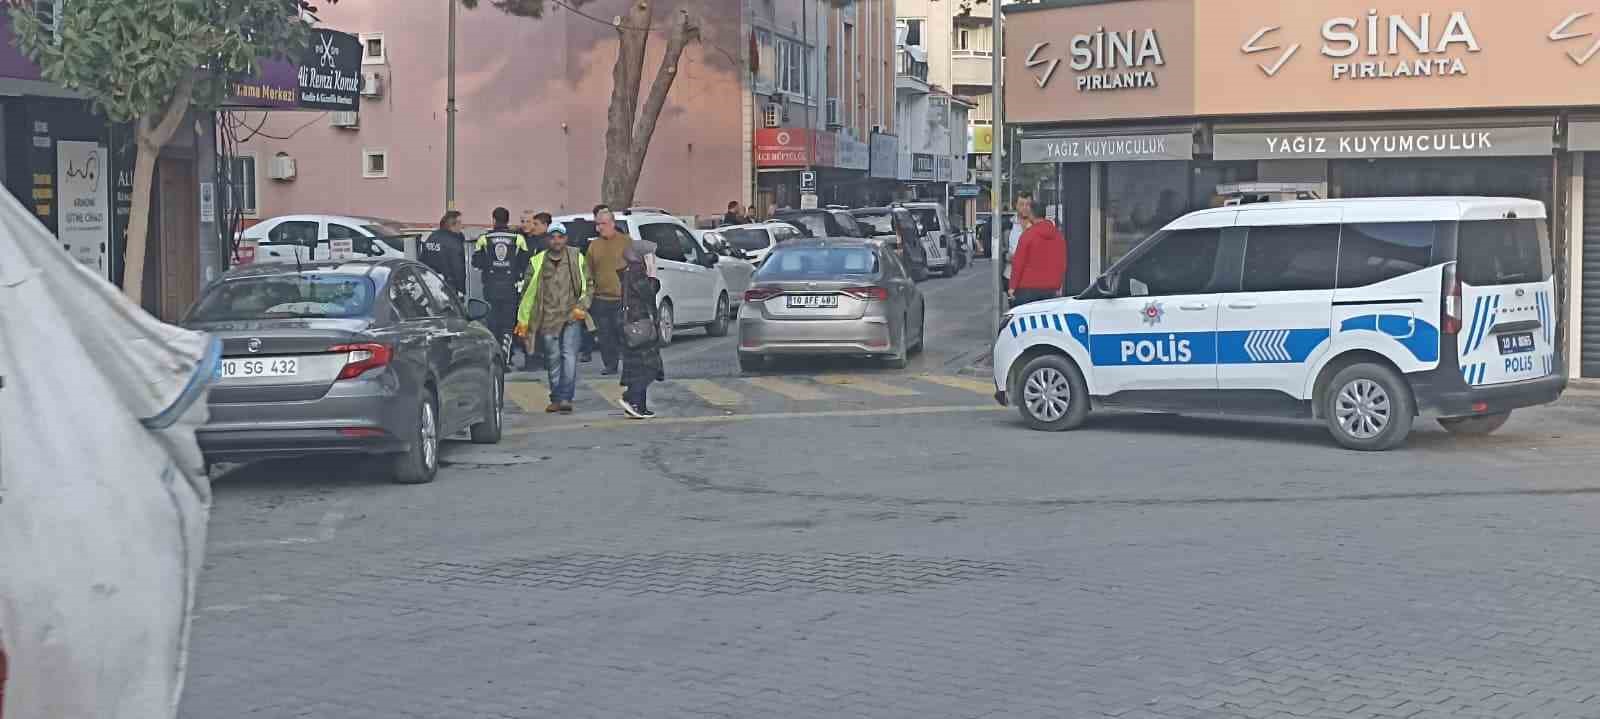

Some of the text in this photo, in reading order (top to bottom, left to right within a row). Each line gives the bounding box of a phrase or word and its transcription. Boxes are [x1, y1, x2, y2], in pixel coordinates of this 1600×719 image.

[1320, 8, 1482, 57] SİNA
[1070, 25, 1165, 71] SİNA
[309, 67, 334, 89] Remzi
[1331, 57, 1467, 81] PIRLANTA
[1076, 71, 1157, 91] PIRLANTA
[1047, 137, 1165, 157] YAĞIZ KUYUMCULUK
[1266, 131, 1492, 153] YAĞIZ KUYUMCULUK
[802, 172, 814, 187] P
[1120, 334, 1192, 362] POLİS
[223, 360, 296, 375] 10 SG 432
[1505, 355, 1533, 373] POLİS
